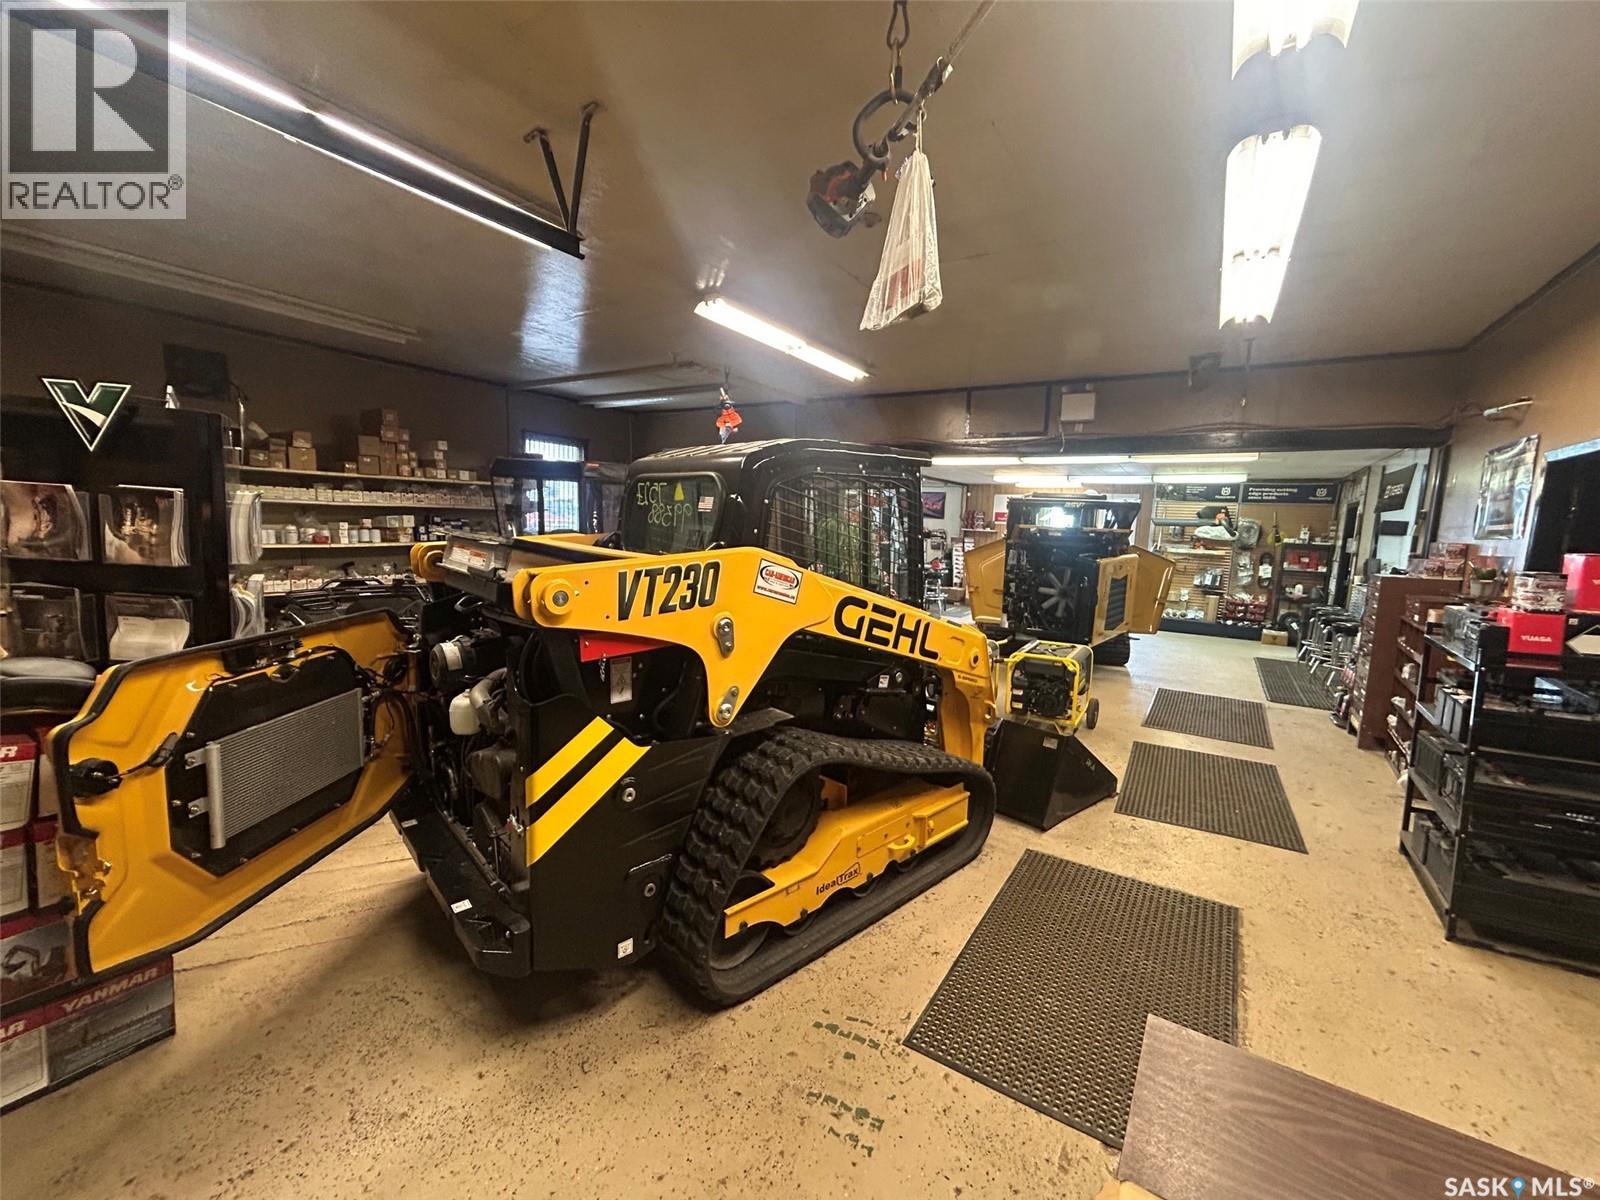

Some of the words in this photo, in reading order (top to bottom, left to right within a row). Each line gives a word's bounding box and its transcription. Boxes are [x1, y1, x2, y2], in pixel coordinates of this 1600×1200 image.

[617, 561, 720, 621] VT230
[833, 595, 939, 661] GEHL
[1520, 635, 1553, 643] YUASA
[62, 967, 158, 1013] YANMAR
